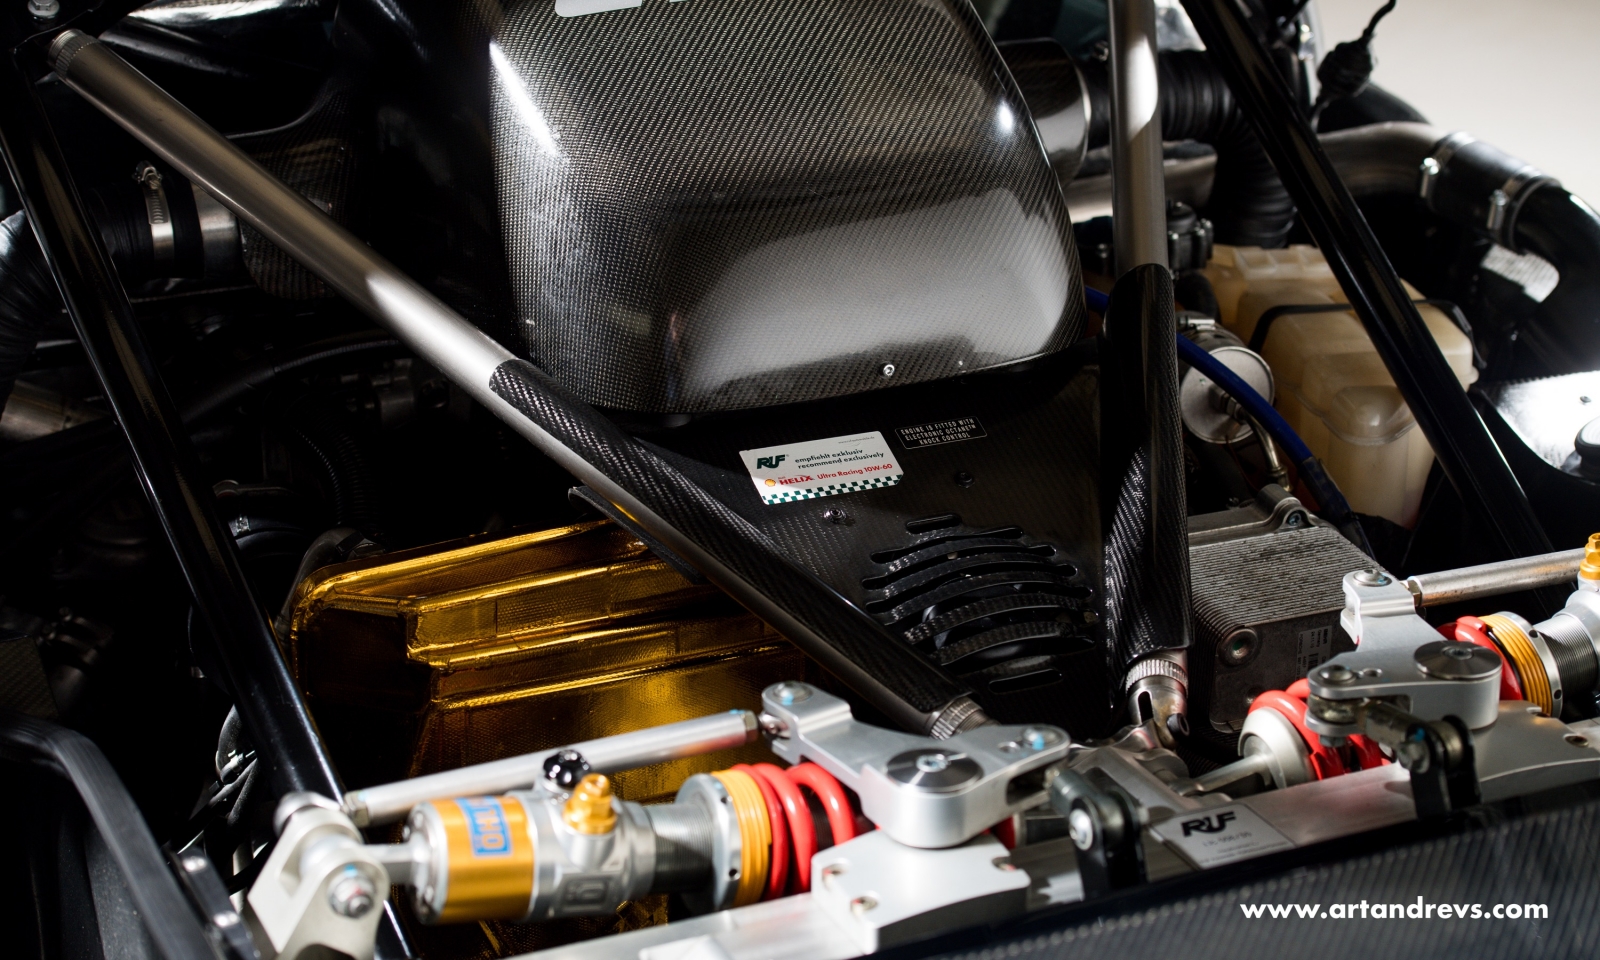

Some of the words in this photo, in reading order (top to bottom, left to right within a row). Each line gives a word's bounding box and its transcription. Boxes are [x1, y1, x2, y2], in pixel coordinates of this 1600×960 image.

[901, 426, 925, 435] ENGINE
[935, 421, 957, 430] FITTED
[958, 418, 975, 426] WITH
[905, 429, 944, 440] ELECTRONIC
[919, 437, 940, 445] KNOCK
[941, 432, 971, 441] CONTROL
[795, 453, 831, 463] empfiehlt
[832, 449, 863, 459] exklusiv
[798, 458, 842, 469] recommend
[844, 452, 884, 462] exclusively
[779, 475, 814, 486] HELIX
[837, 469, 864, 477] Racing
[864, 463, 893, 473] 10W-60
[1181, 811, 1237, 838] RUF
